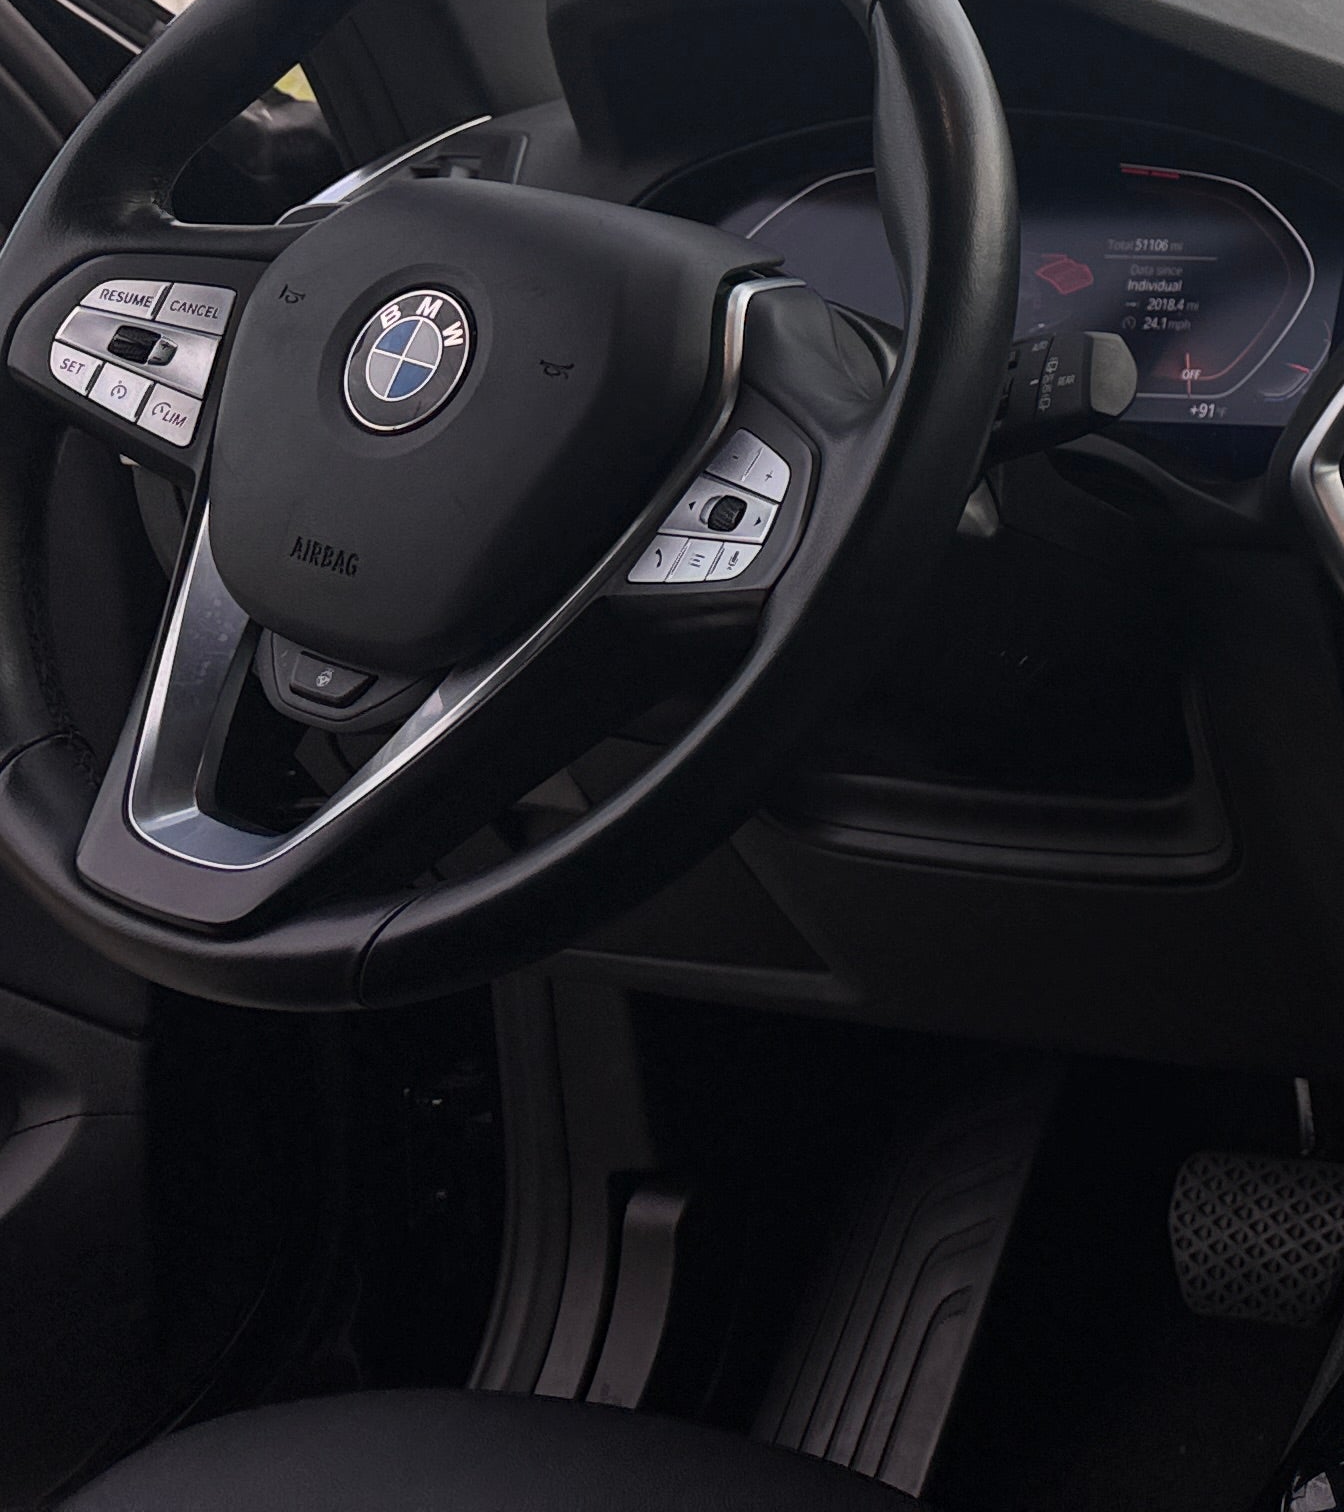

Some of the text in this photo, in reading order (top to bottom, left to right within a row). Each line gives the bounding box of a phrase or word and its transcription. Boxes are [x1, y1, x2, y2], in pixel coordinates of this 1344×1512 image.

[1135, 238, 1169, 252] 51106
[1127, 279, 1183, 293] Individual
[100, 288, 154, 308] RESUME
[1147, 297, 1185, 312] 2018.4
[170, 300, 219, 320] CANCEL
[380, 296, 464, 347] BMW
[1143, 316, 1168, 331] 24.1
[60, 358, 86, 375] SET
[1181, 369, 1202, 381] OFF
[162, 409, 188, 427] LIM
[1189, 402, 1216, 419] +91
[290, 536, 360, 577] AIRBAG
